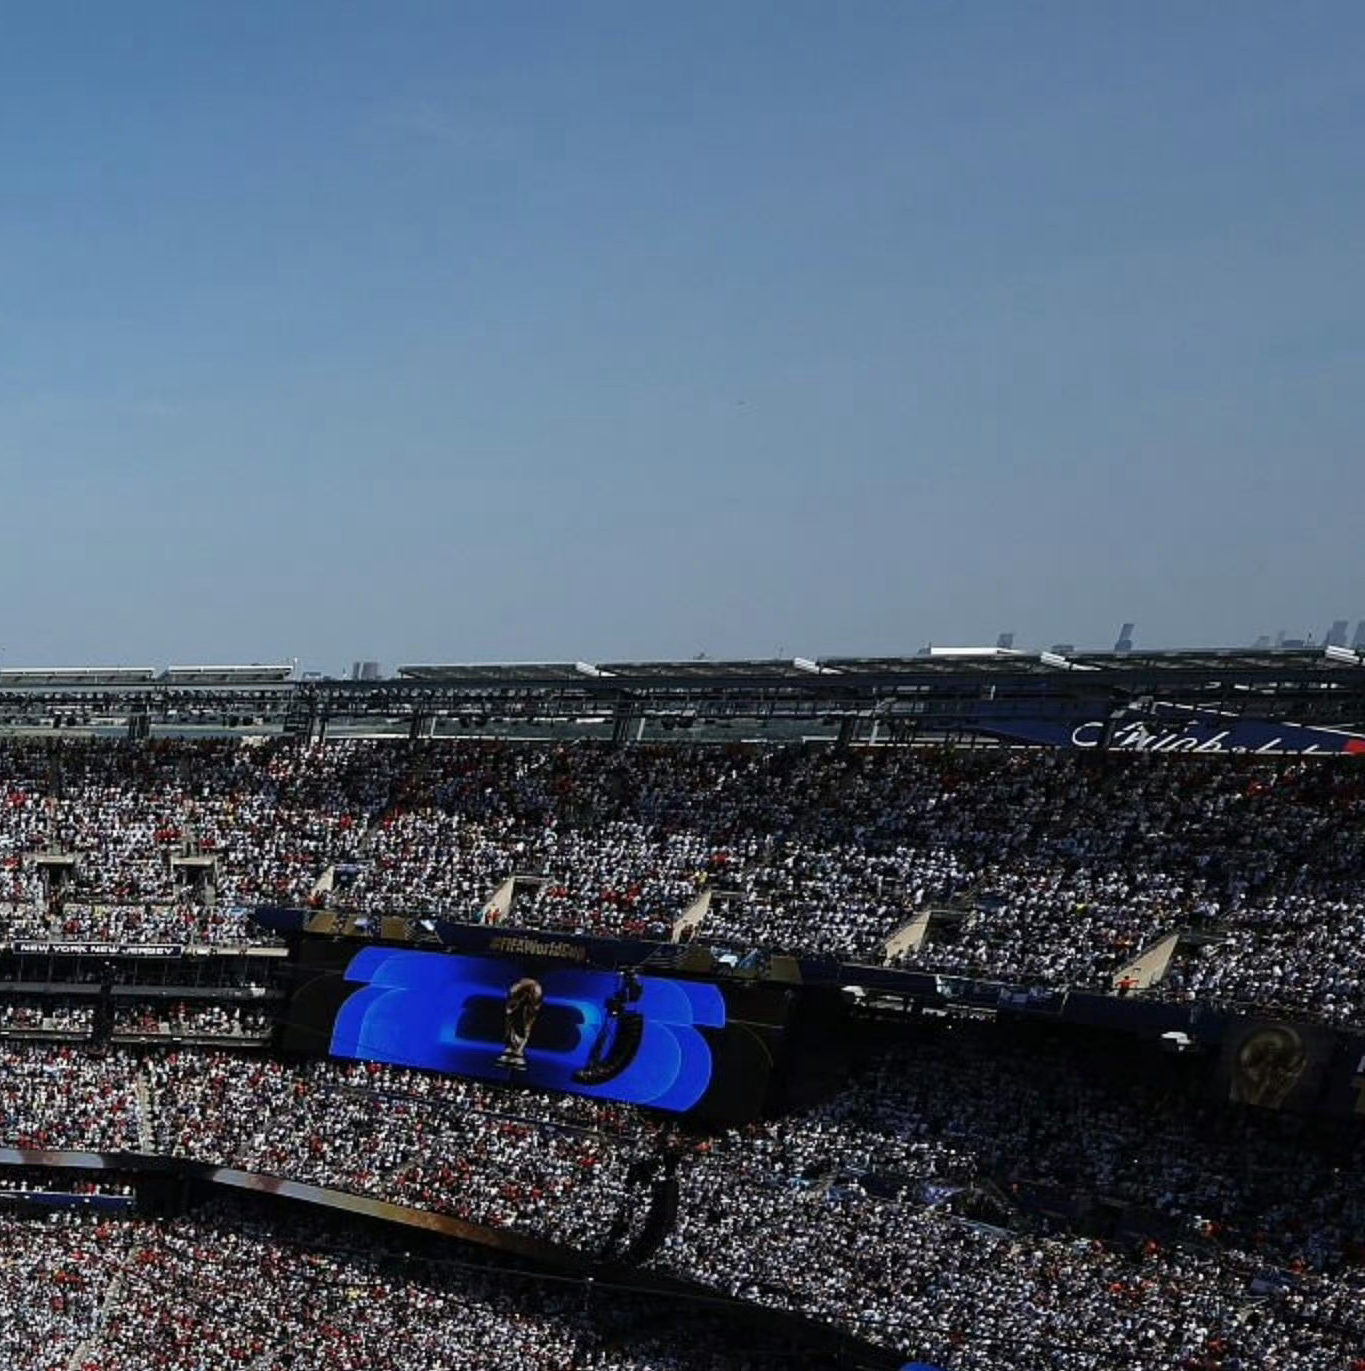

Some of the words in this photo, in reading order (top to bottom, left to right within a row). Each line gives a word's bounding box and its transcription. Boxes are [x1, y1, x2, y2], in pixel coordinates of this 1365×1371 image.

[20, 944, 49, 952] NEW
[53, 945, 87, 953] YORK
[121, 947, 174, 955] JERSEY
